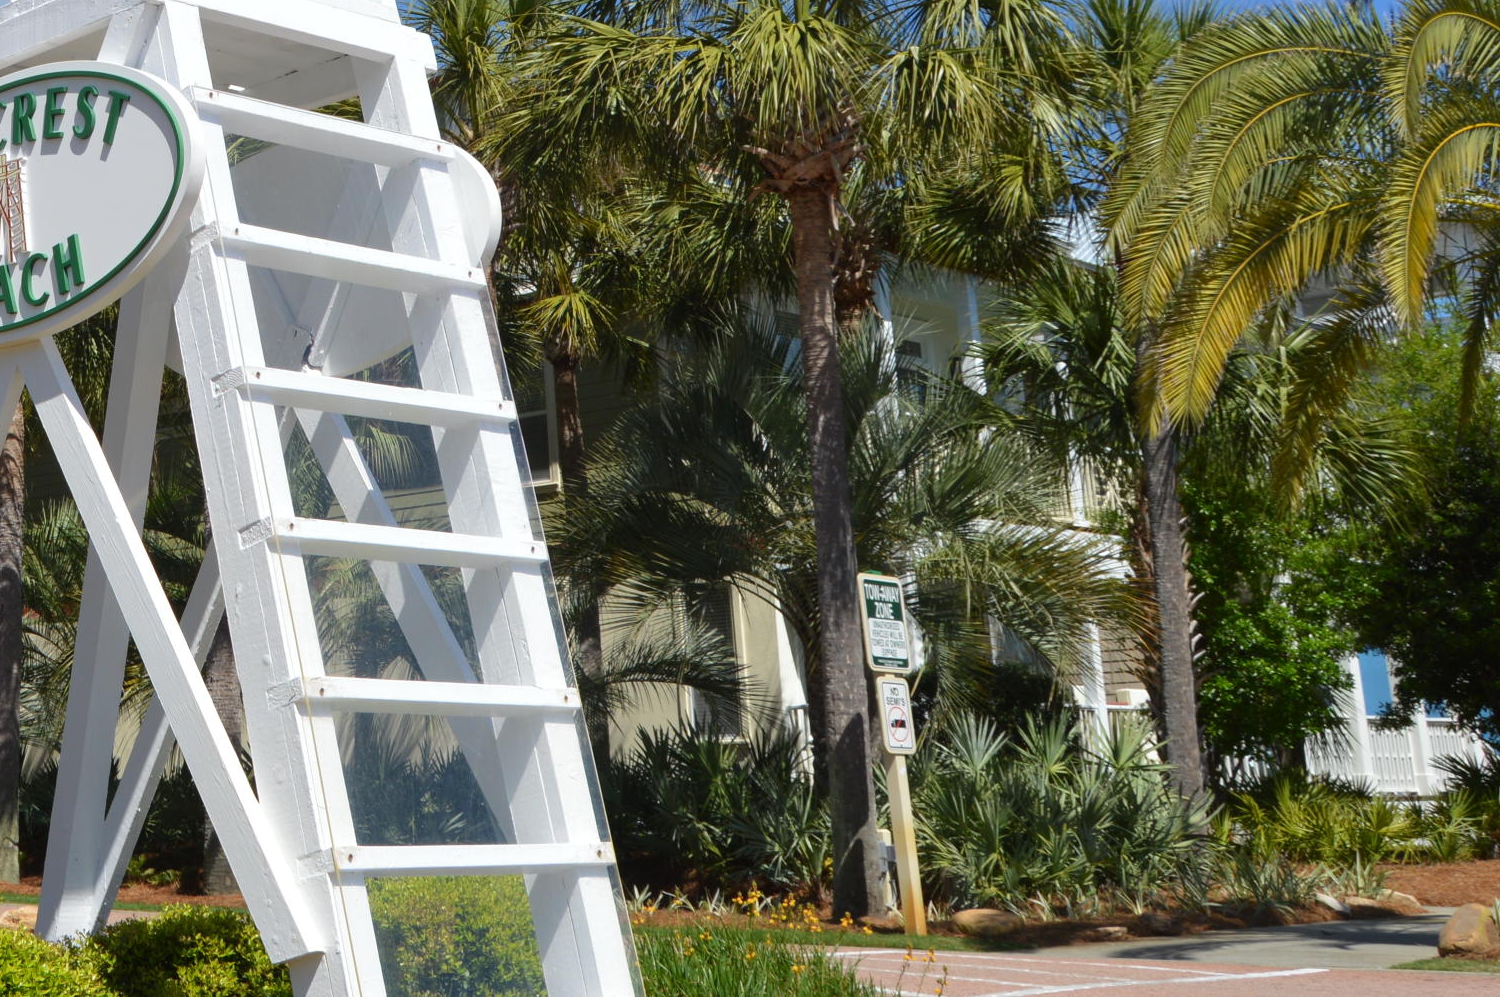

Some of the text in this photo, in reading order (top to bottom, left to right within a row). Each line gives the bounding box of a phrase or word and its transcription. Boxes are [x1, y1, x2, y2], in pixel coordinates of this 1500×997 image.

[864, 583, 899, 602] TOW-AWAY
[875, 603, 894, 619] ZONE
[890, 687, 899, 696] NO
